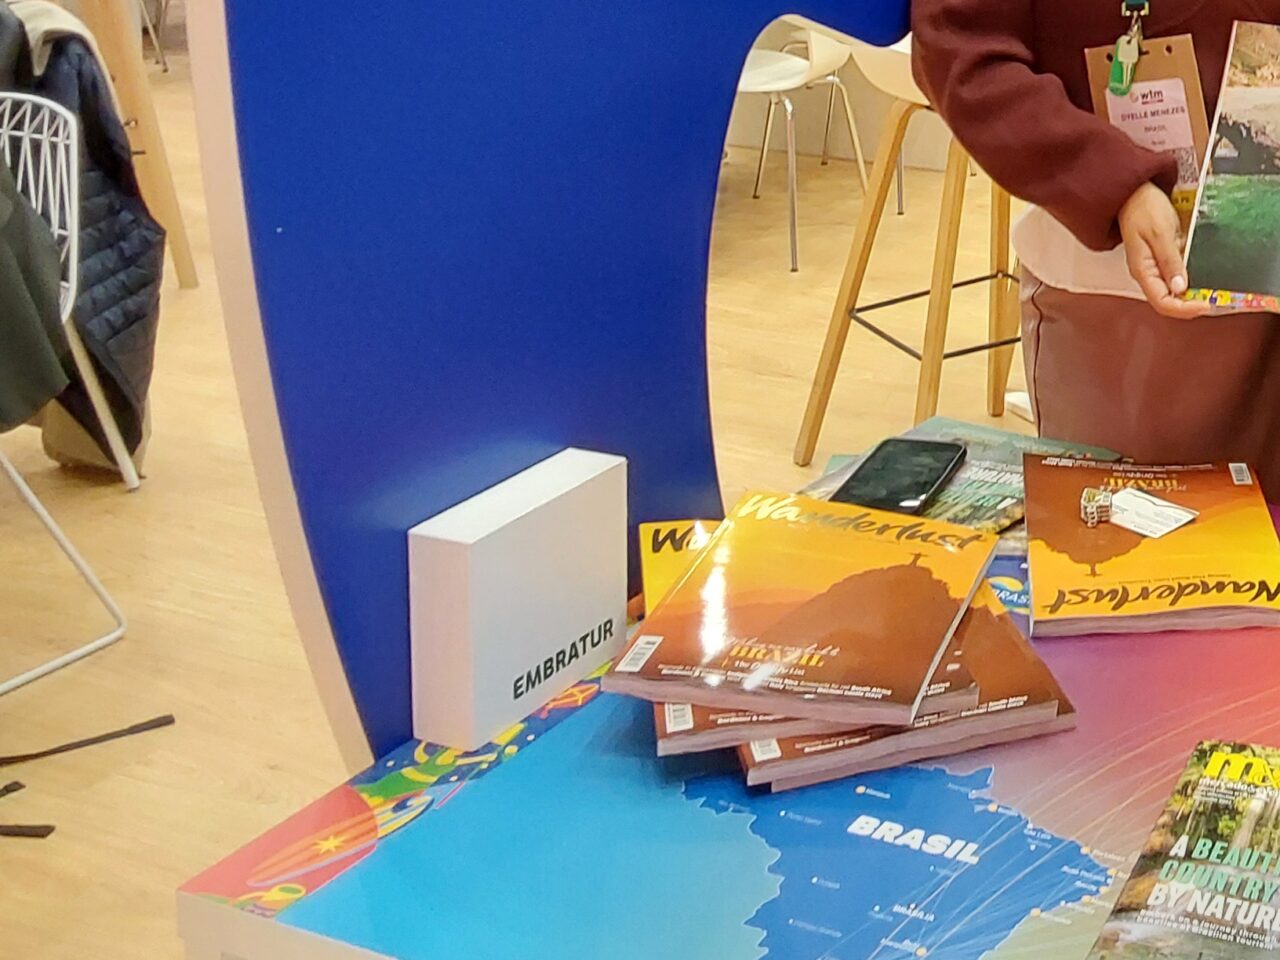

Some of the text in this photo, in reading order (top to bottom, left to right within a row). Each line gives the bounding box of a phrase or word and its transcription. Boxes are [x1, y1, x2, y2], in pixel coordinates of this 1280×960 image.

[737, 493, 985, 552] Wanderlust
[513, 618, 613, 700] EMBRATUR
[847, 814, 979, 865] BRASIL
[1169, 834, 1189, 857] A
[1147, 883, 1191, 907] BY
[1159, 859, 1280, 904] COUNTRY
